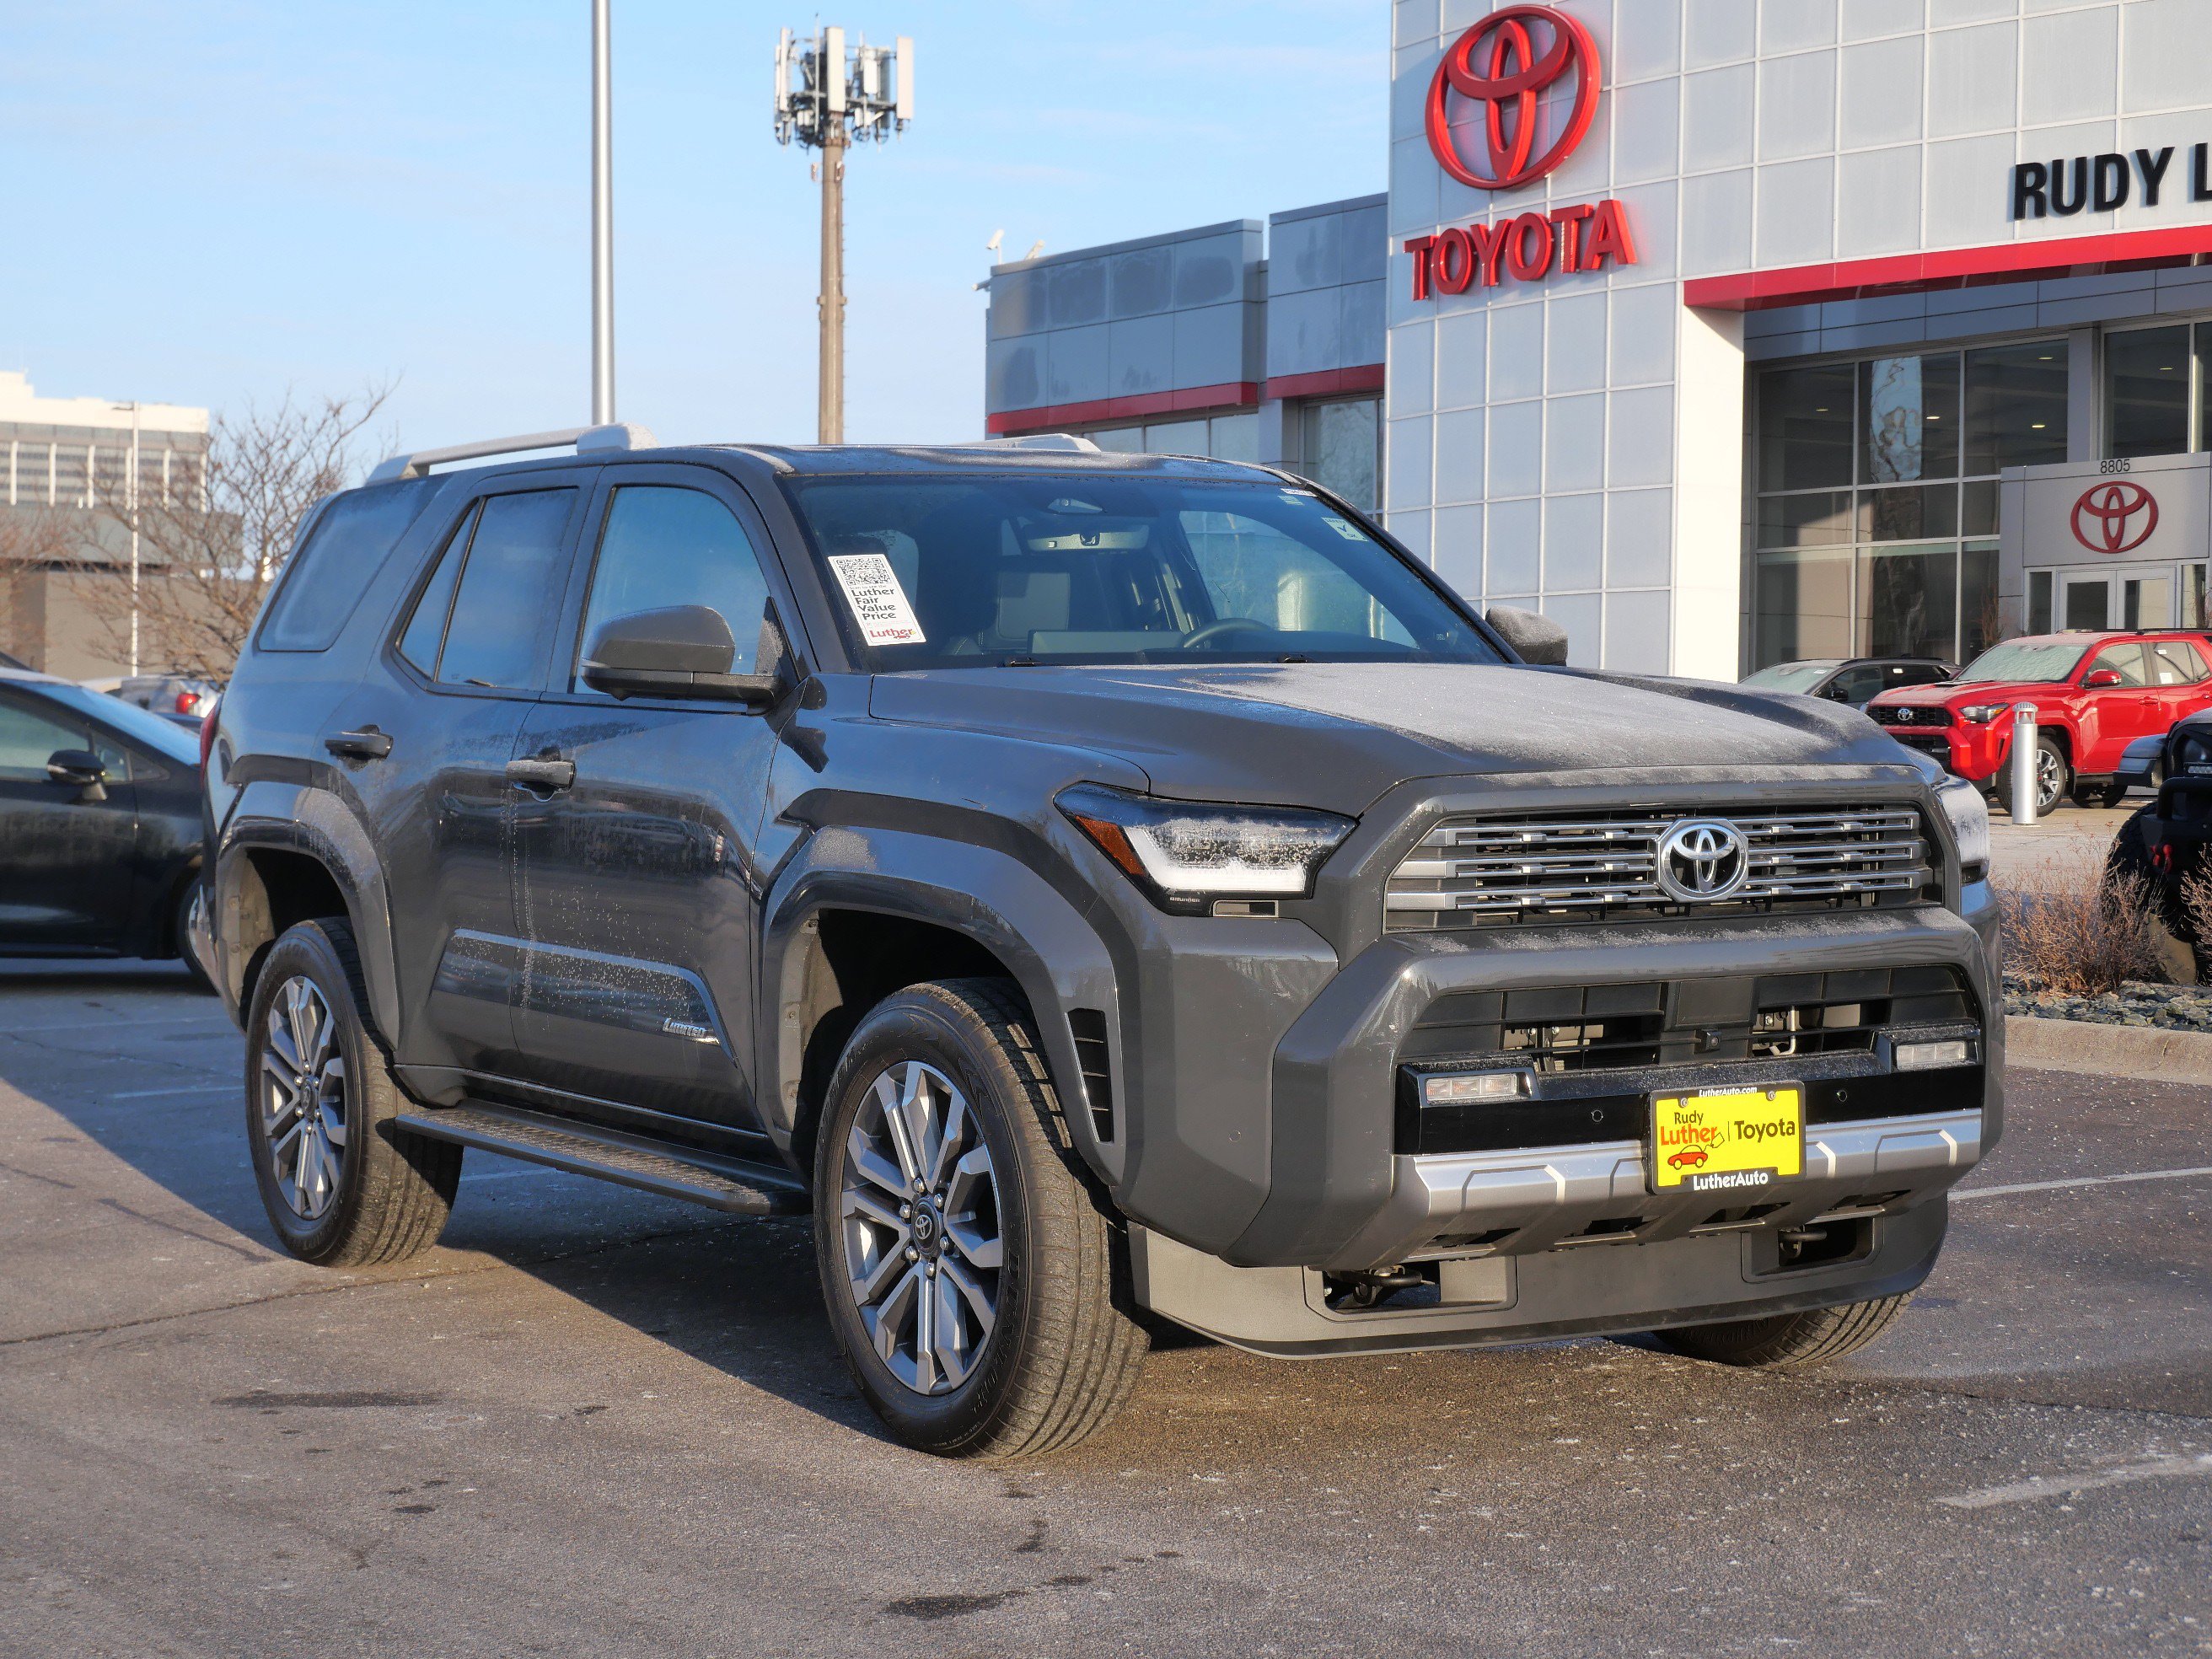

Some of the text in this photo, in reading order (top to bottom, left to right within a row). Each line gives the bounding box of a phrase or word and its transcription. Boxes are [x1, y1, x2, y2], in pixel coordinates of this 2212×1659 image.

[2014, 146, 2175, 221] RUDY
[1404, 200, 1637, 301] TOYOTA
[2100, 459, 2130, 474] 8805
[851, 588, 894, 597] Luther
[855, 596, 878, 604] Fair
[857, 604, 896, 612] Value
[862, 611, 896, 620] Price
[869, 628, 913, 638] Luther
[1699, 1087, 1757, 1098] LutherAuto.com
[1674, 1110, 1704, 1125] Rudy
[1661, 1123, 1717, 1146] Luther
[1734, 1118, 1796, 1143] Toyota
[1693, 1171, 1769, 1191] LutherAuto
